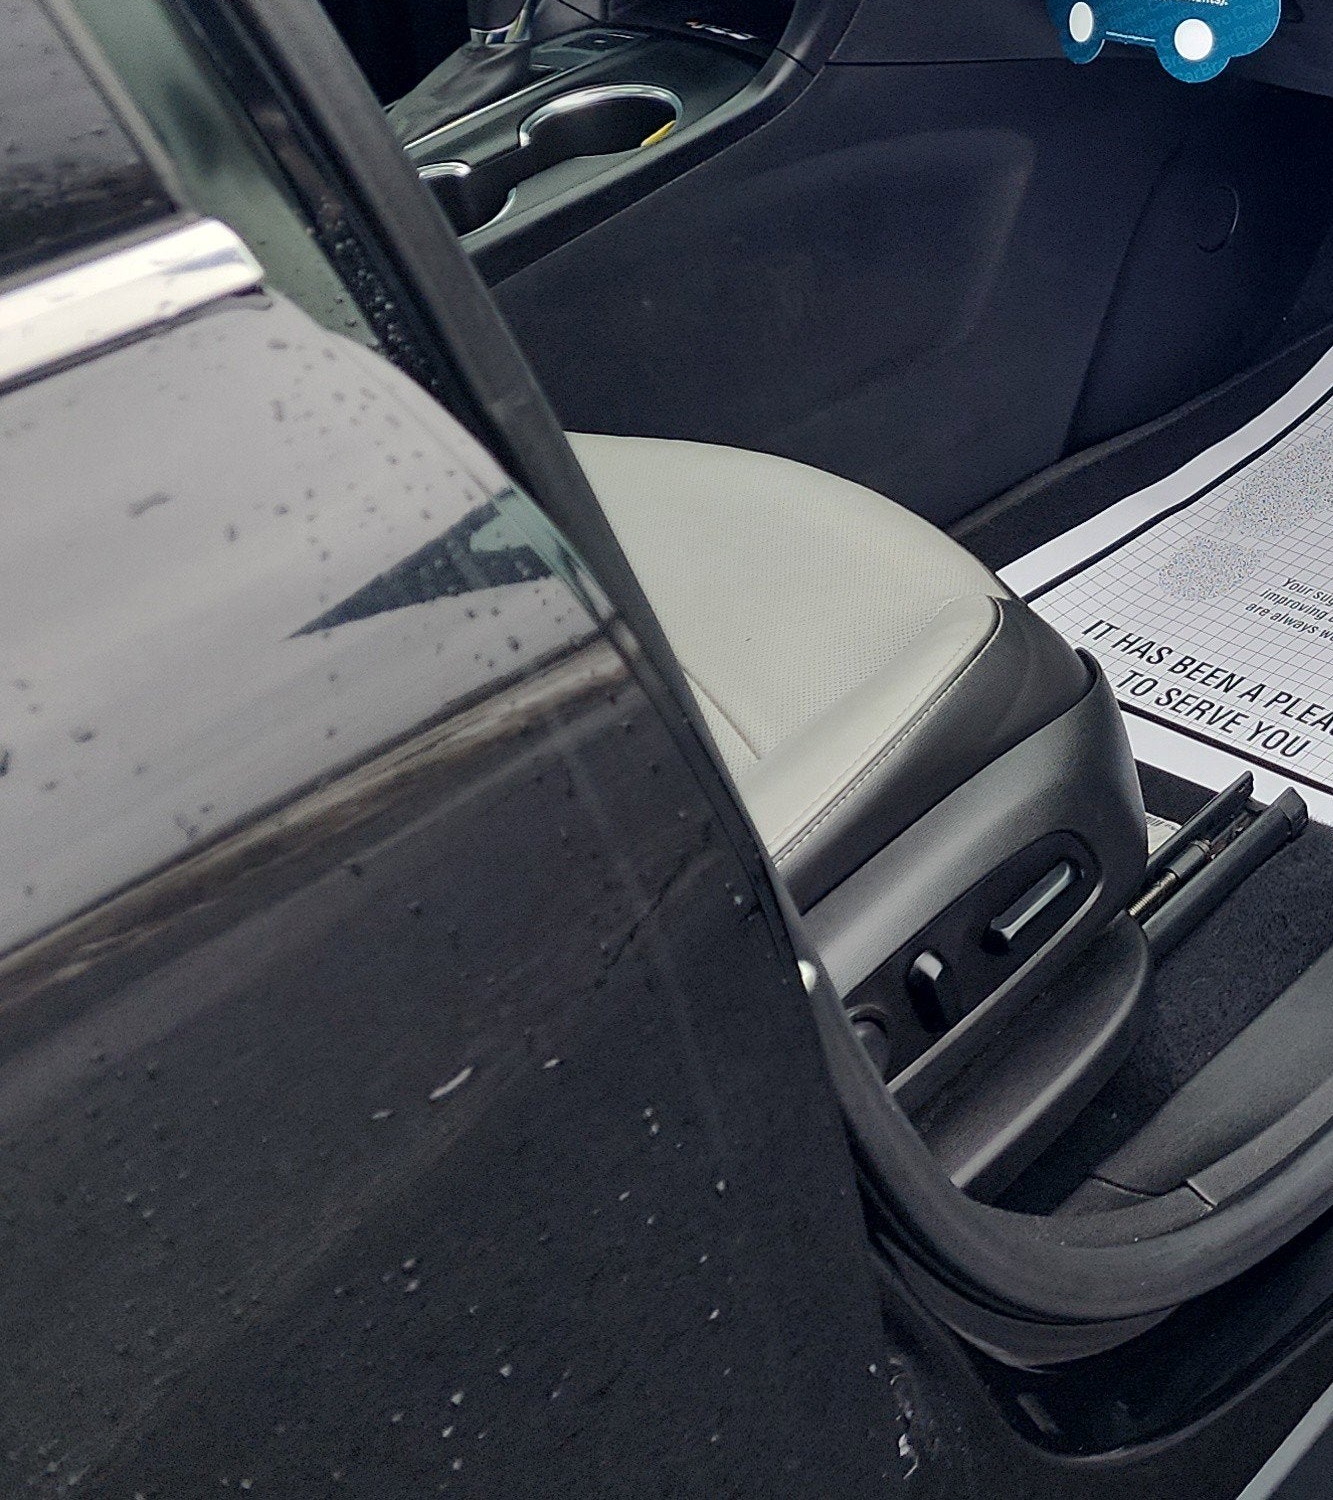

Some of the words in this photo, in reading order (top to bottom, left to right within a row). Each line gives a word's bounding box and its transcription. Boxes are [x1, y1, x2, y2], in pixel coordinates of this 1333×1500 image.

[1281, 578, 1314, 596] Your
[1245, 603, 1271, 617] are
[1270, 611, 1319, 634] always
[1260, 588, 1328, 621] improving
[1082, 620, 1122, 642] IT
[1111, 632, 1173, 665] HAS
[1167, 655, 1248, 694] BEEN
[1244, 683, 1267, 702] A
[1116, 670, 1159, 696] TO
[1154, 687, 1250, 734] SERVE
[1245, 720, 1312, 758] YOU
